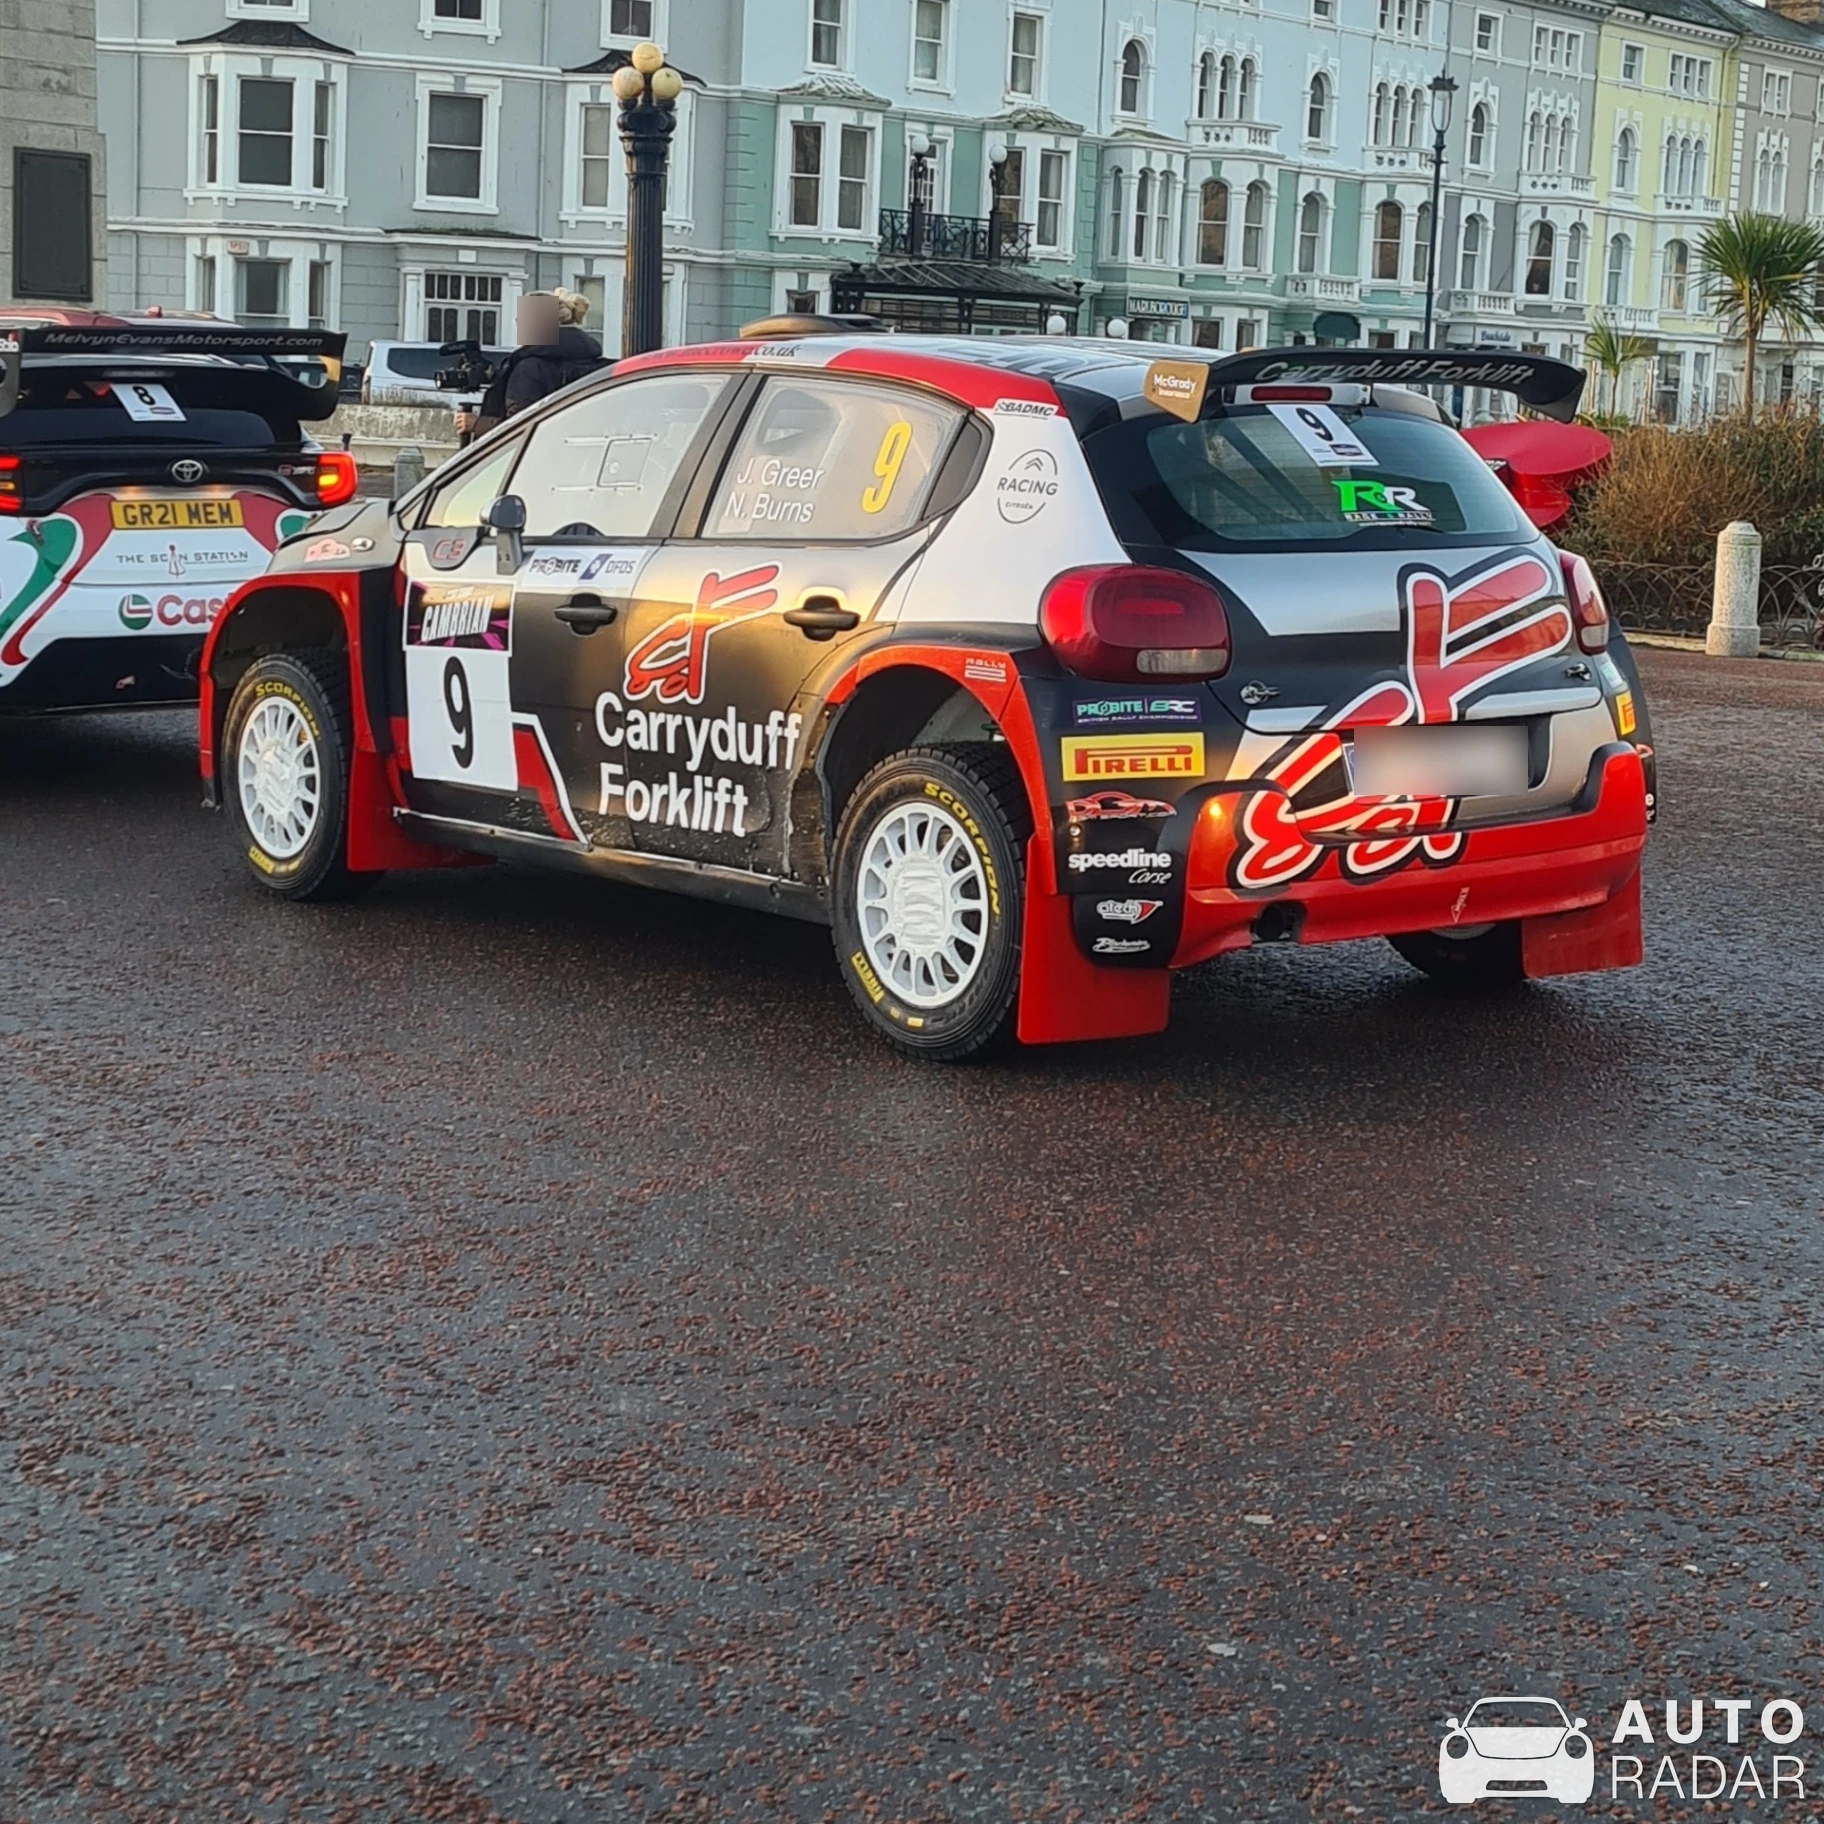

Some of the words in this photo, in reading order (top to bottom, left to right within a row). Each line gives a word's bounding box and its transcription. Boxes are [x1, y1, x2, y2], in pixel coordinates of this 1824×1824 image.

[45, 333, 323, 347] MelvynEvansMotorsport.com
[1154, 373, 1197, 394] McGrady
[1255, 359, 1424, 382] Carryduff
[1419, 360, 1536, 384] Forklift
[132, 386, 156, 406] 8
[1296, 407, 1334, 442] 9
[737, 459, 752, 485] J.
[761, 460, 824, 490] Greer
[862, 422, 912, 513] 9
[997, 477, 1058, 496] RACING
[122, 503, 178, 525] GR21
[186, 502, 233, 524] MEM
[724, 493, 746, 518] N.
[752, 494, 814, 523] Burns
[117, 554, 144, 564] THE
[605, 560, 636, 574] DFDS
[156, 592, 234, 626] Cas
[421, 595, 495, 642] CAMBRIAN
[443, 656, 474, 769] 9
[1077, 700, 1143, 716] PROBITE
[595, 691, 802, 772] Carryduff
[1075, 745, 1193, 774] PIRELLI
[599, 762, 748, 838] Forklift
[924, 782, 1001, 917] SCORPION
[1068, 848, 1172, 872] speedline
[1128, 868, 1172, 884] Corse
